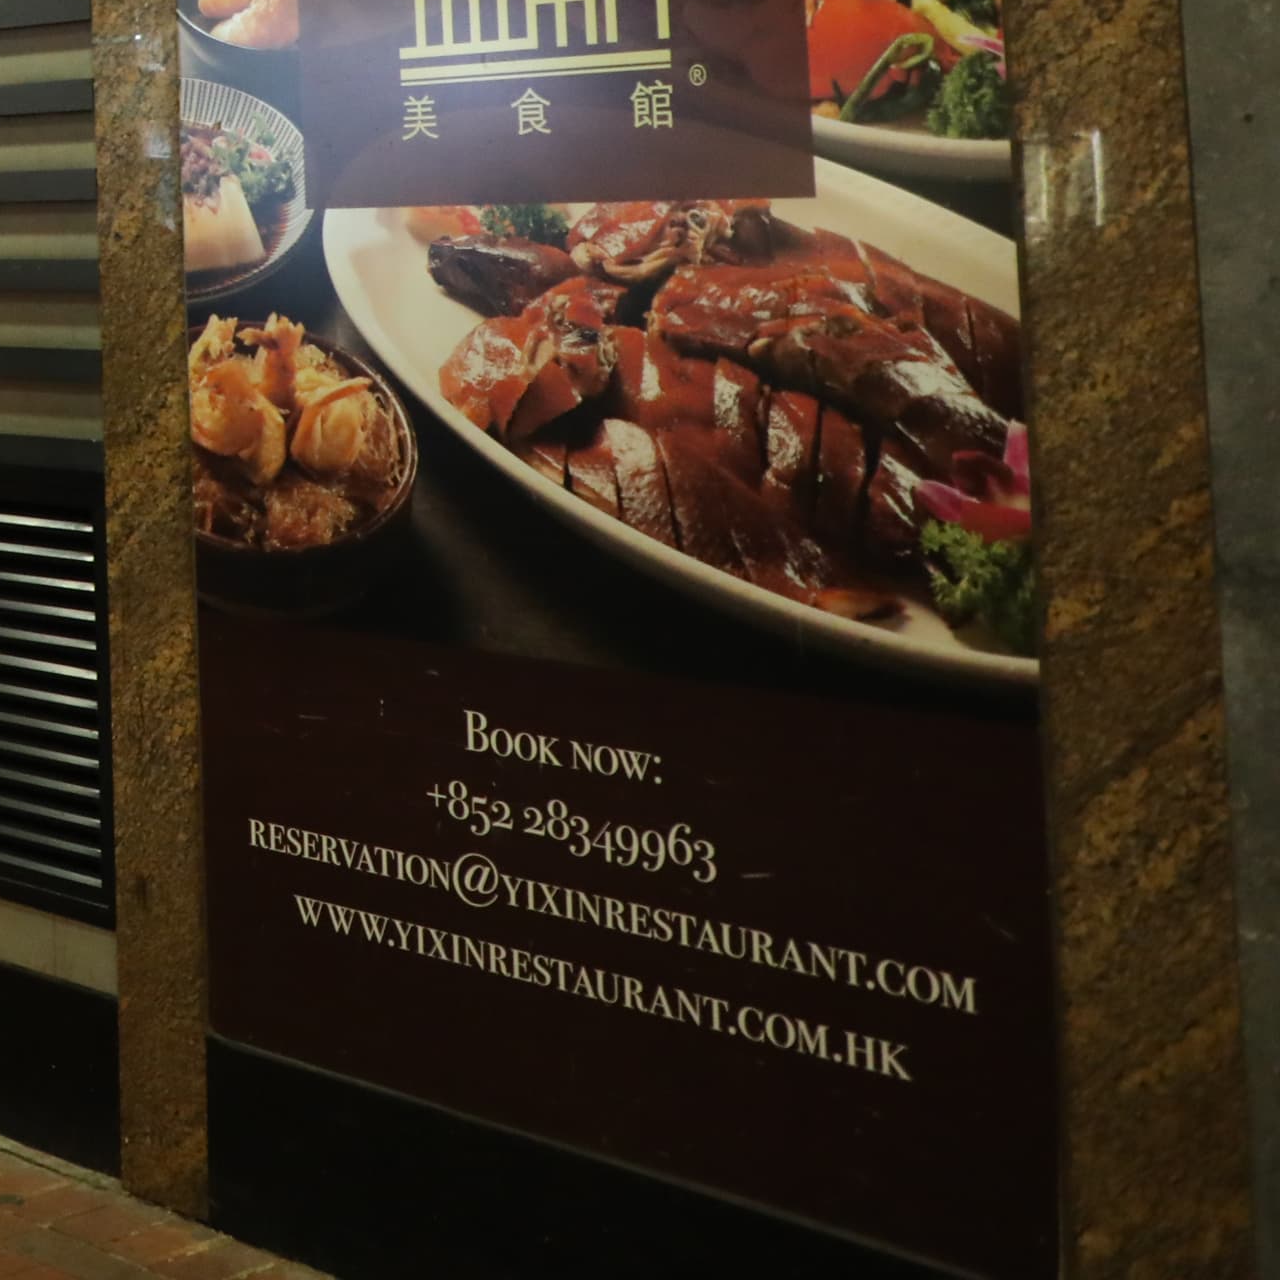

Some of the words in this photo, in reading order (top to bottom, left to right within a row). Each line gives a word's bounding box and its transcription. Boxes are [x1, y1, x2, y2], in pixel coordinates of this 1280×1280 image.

[400, 79, 674, 141] 美食館
[463, 708, 563, 769] BOOK
[570, 738, 663, 785] NOW:
[425, 778, 515, 836] +852
[522, 797, 718, 884] 28349963
